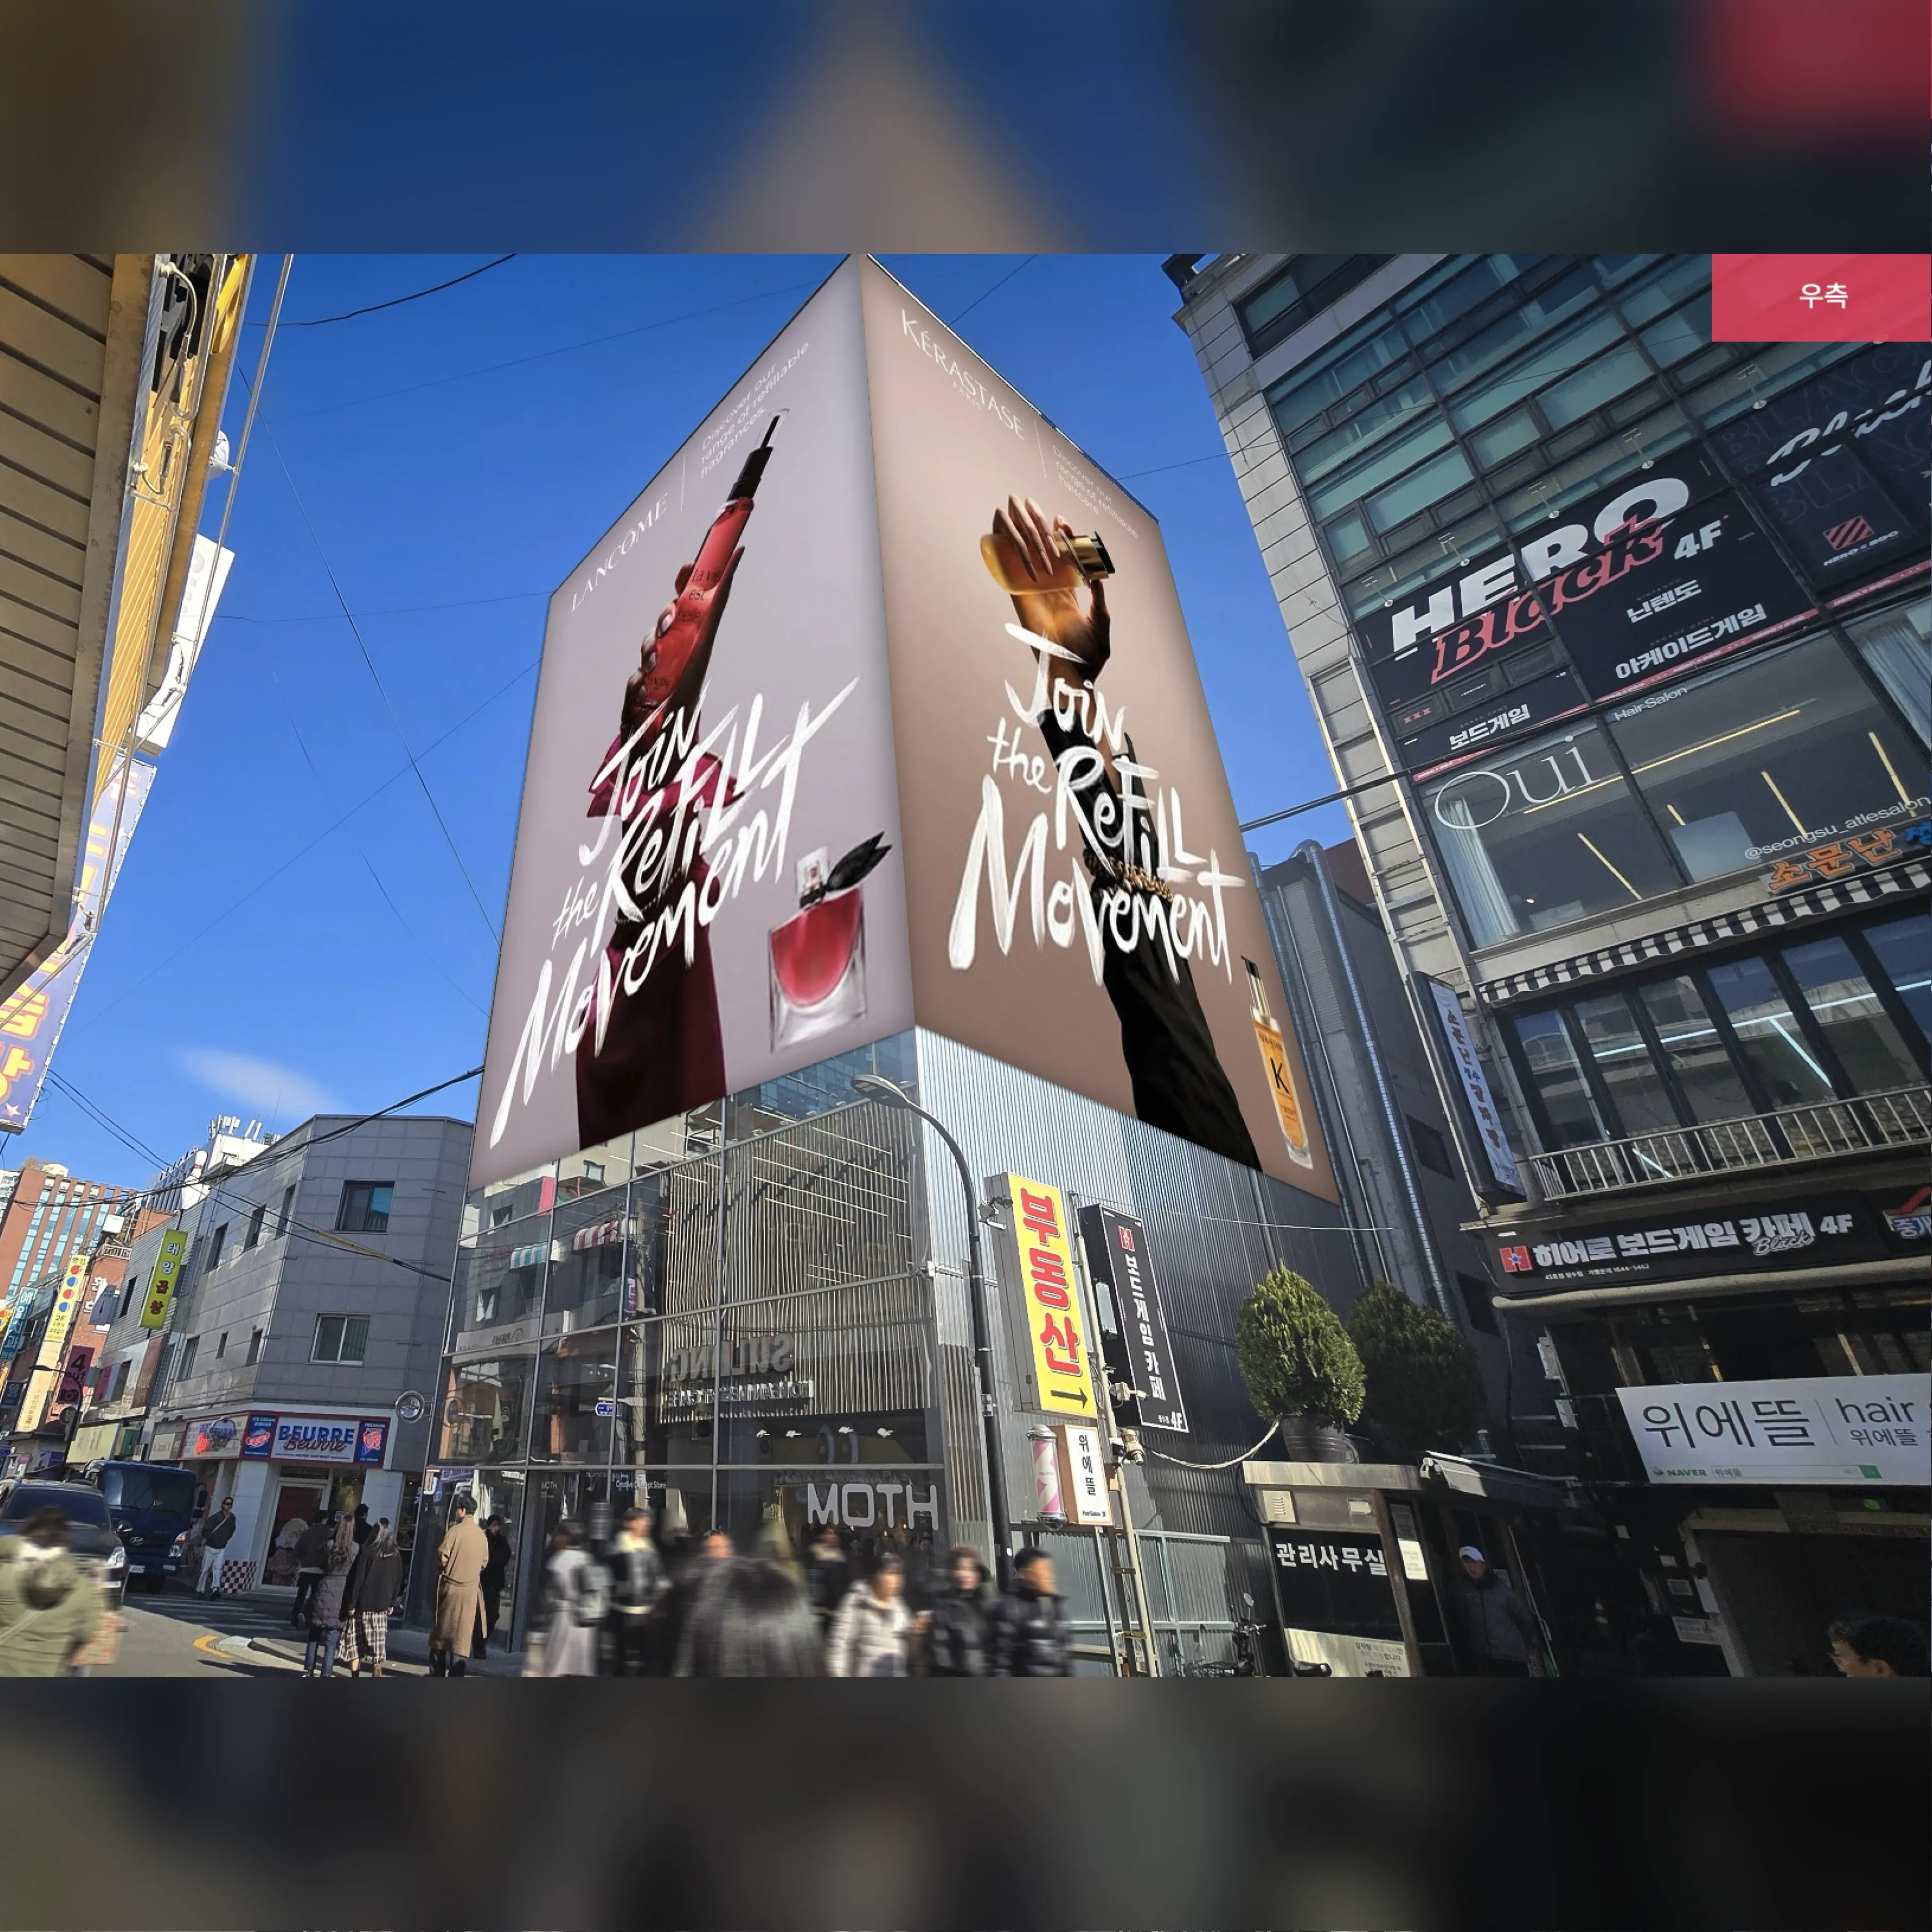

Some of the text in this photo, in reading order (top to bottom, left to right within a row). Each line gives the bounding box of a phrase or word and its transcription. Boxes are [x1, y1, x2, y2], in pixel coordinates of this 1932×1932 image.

[901, 309, 1025, 441] KÉRASTASE
[701, 342, 809, 464] range of refillable
[702, 363, 776, 450] Discover our
[1673, 519, 1724, 561] 4F
[1392, 478, 1690, 653] HERO
[1626, 579, 1702, 623] 닌텐도
[1615, 603, 1767, 679] 아케이드게임
[1644, 687, 1688, 708] Salon
[1449, 704, 1531, 751] 보드게임
[987, 718, 1053, 795] the
[1434, 735, 1601, 829] Oui
[1768, 827, 1903, 894] 소문난
[552, 876, 601, 950] the
[1269, 1057, 1290, 1095] K
[1533, 1236, 1617, 1267] 히어로
[1616, 1221, 1741, 1257] 보드게임
[1739, 1213, 1816, 1243] 카페
[1819, 1213, 1853, 1234] 4F
[1753, 1230, 1815, 1256] Black
[1125, 1253, 1155, 1348] 보드게임
[71, 1354, 86, 1372] 4
[278, 1425, 355, 1444] BEURRE
[1171, 1411, 1183, 1429] 4F
[1643, 1396, 1915, 1449] 위에뜰 hair
[1850, 1428, 1919, 1447] 위에뜰
[807, 1482, 939, 1530] MOTH
[1276, 1543, 1388, 1577] 관리사무실
